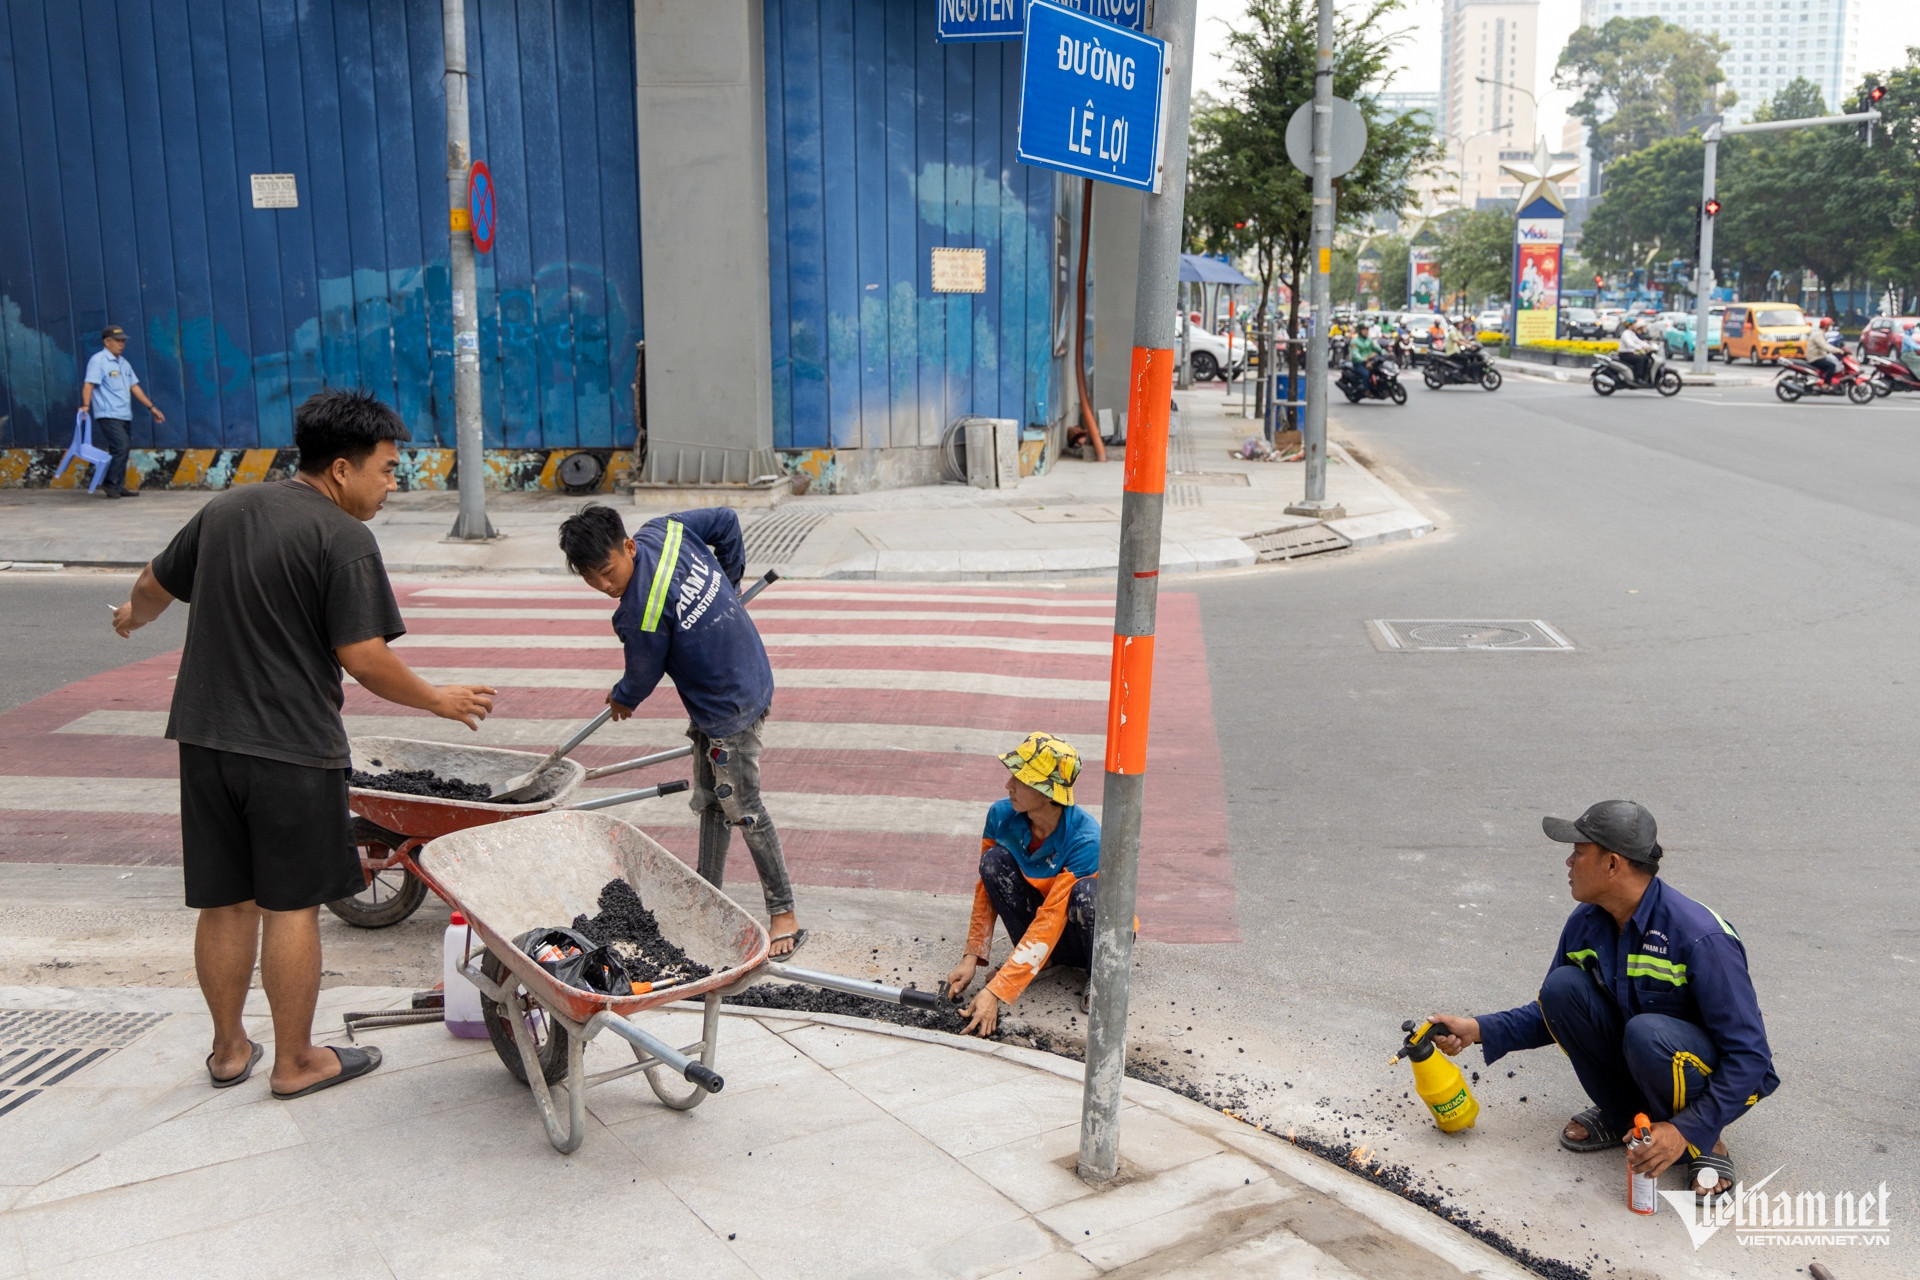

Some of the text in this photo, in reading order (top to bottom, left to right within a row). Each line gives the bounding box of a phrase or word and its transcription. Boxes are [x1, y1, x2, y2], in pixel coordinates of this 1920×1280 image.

[1057, 34, 1136, 91] ĐƯỜNG
[1068, 98, 1129, 173] LÊ LỢI
